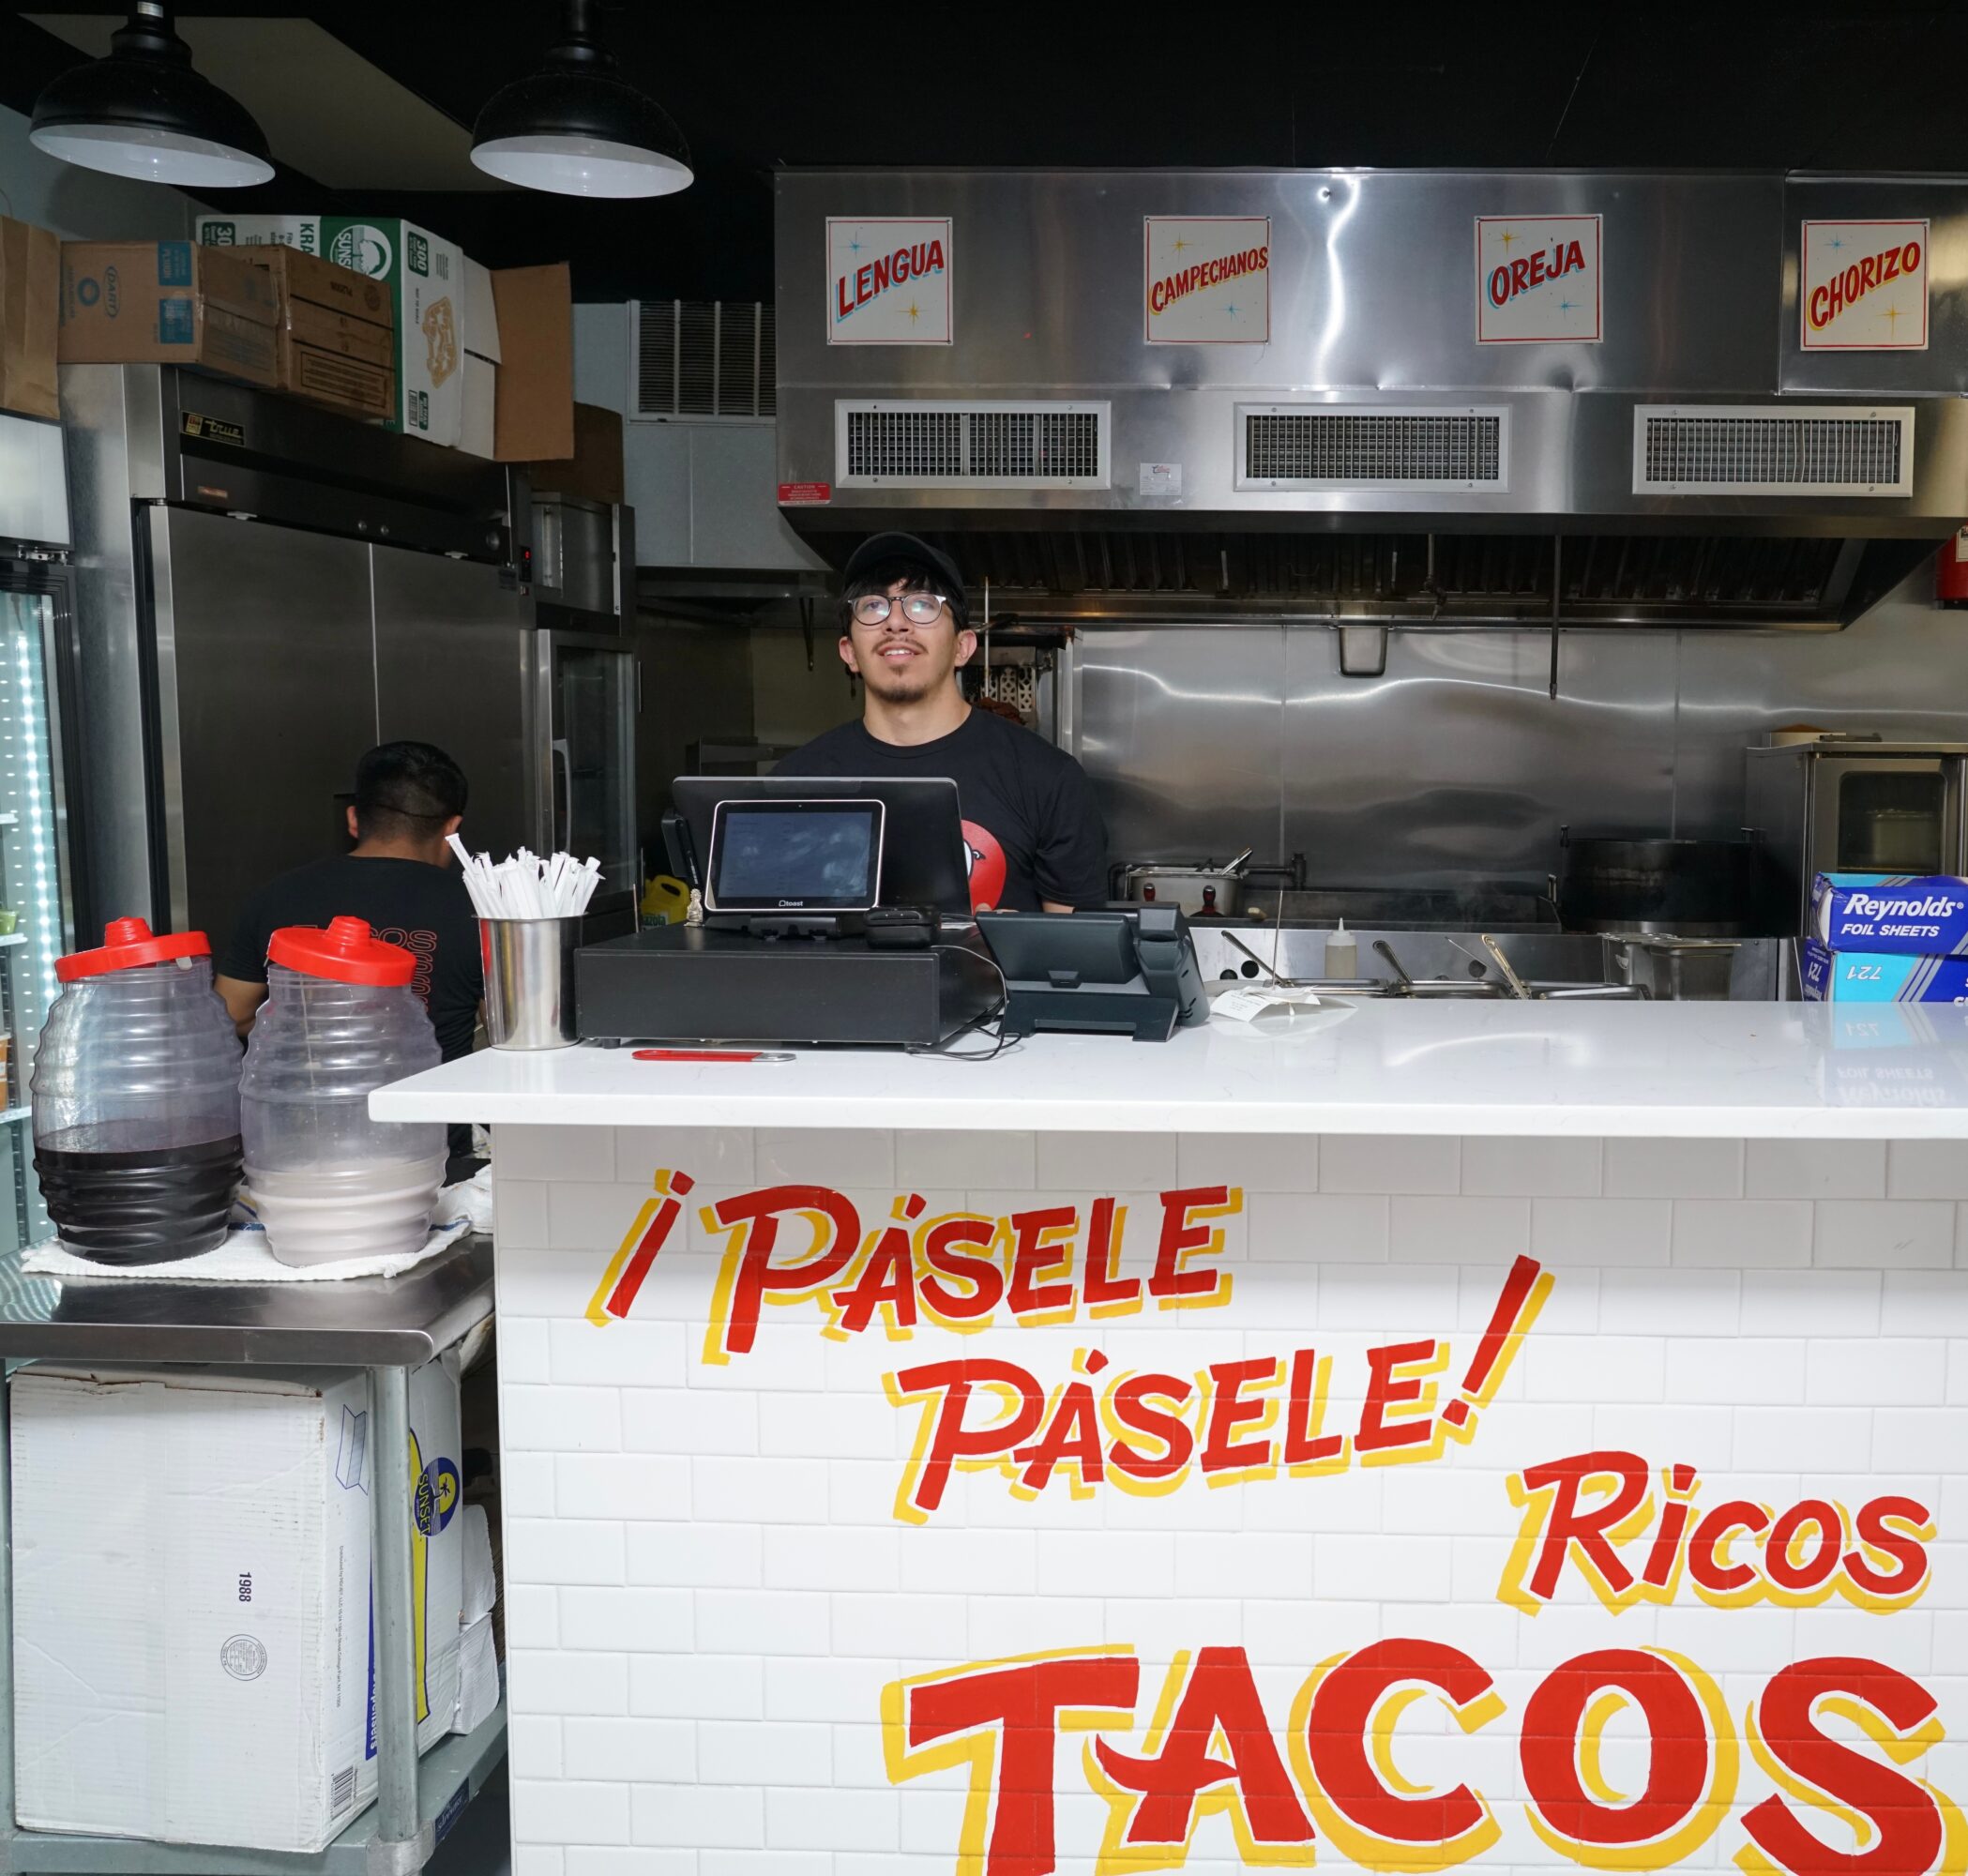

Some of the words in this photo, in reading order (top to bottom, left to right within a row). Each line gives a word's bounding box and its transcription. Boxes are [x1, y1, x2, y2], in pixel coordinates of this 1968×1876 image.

[216, 226, 232, 246] 30
[300, 223, 314, 254] KRA
[416, 239, 428, 271] 300
[837, 239, 945, 321] LENGUA
[1150, 246, 1269, 314] CAMPECHANOS
[1489, 240, 1586, 308] OREJA
[1809, 241, 1922, 329] CHORIZO
[204, 418, 243, 438] true
[1842, 893, 1955, 921] Reynolds
[1841, 923, 1874, 936] FOIL
[1879, 924, 1941, 937] SHEETS
[1845, 964, 1882, 981] 721
[895, 1255, 1543, 1512] PÁSELE!
[417, 1473, 431, 1536] SUNSET
[238, 1571, 252, 1602] 1988
[905, 1638, 1945, 1876] TACOS
